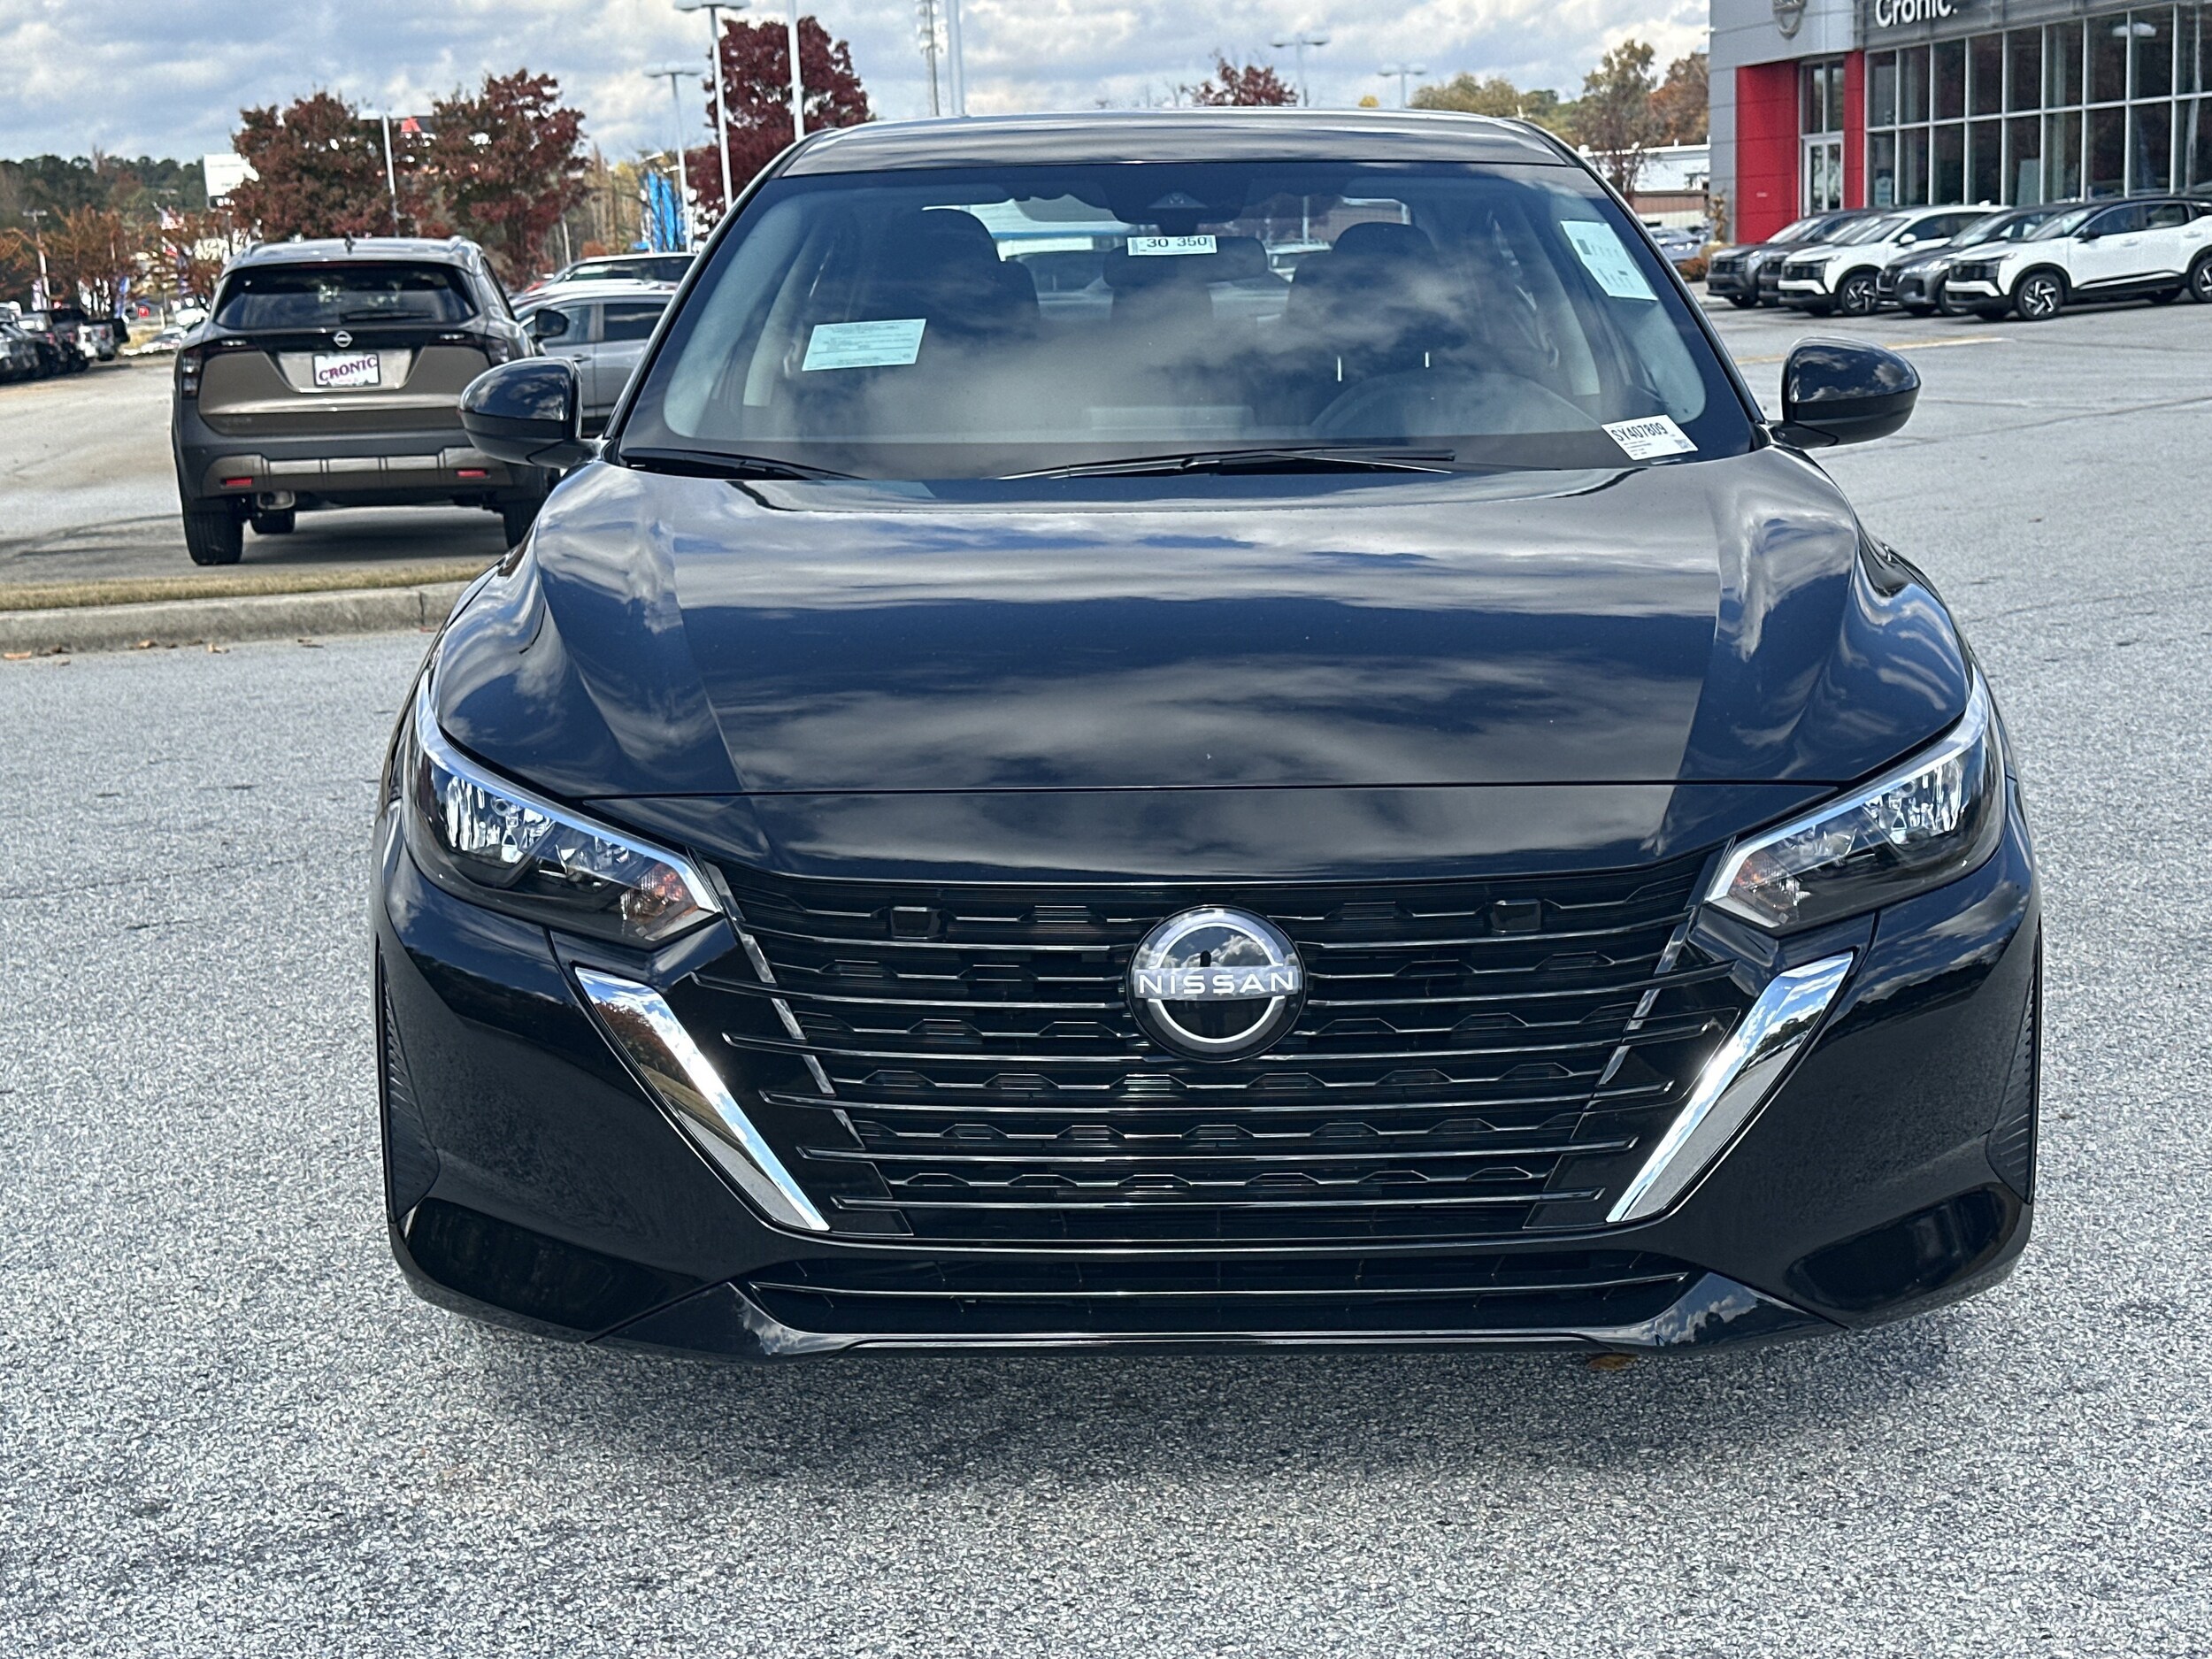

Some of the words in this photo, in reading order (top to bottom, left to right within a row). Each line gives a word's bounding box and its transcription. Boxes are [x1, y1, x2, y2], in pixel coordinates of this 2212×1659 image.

[1146, 238, 1169, 248] 30
[1177, 236, 1208, 247] 350
[319, 357, 378, 381] CRONIC
[1139, 971, 1294, 995] NISSAN
